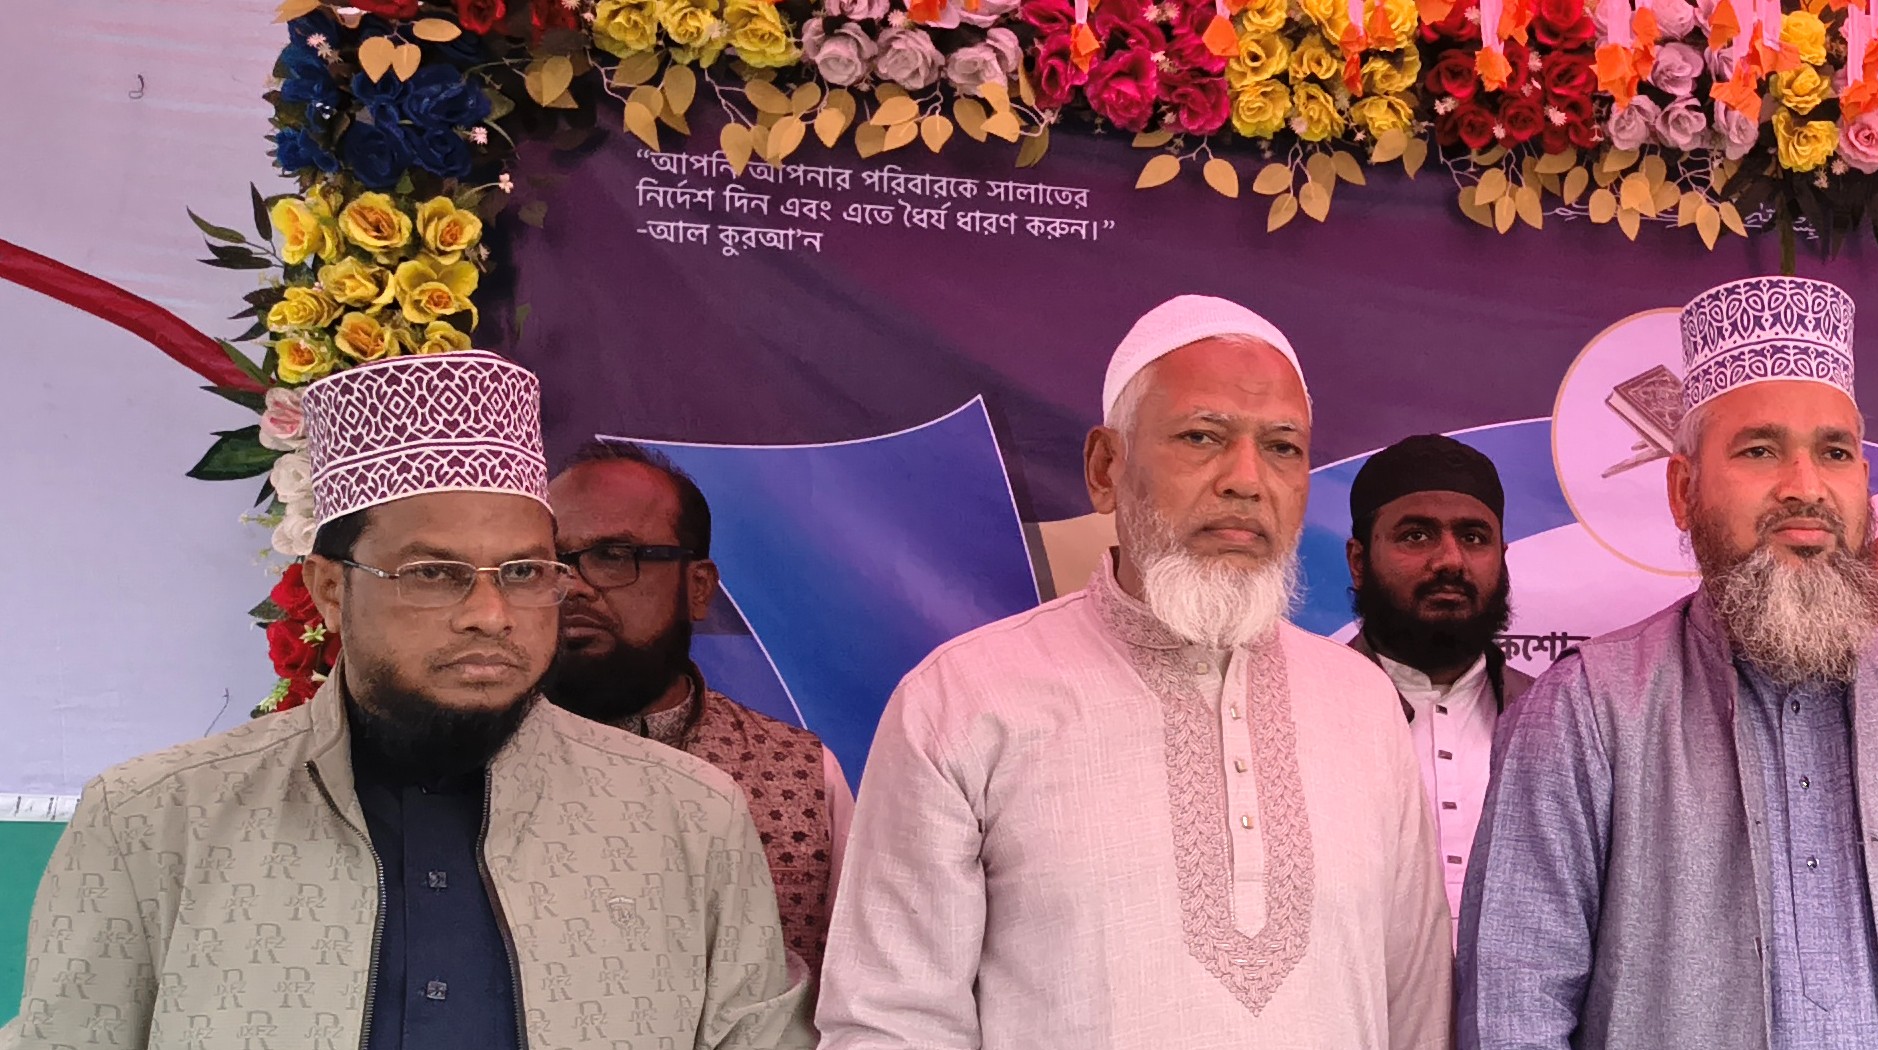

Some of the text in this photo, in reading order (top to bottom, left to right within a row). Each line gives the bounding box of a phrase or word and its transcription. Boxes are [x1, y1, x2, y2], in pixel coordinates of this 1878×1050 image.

[636, 177, 715, 212] নির্দেশ
[723, 183, 771, 215] দিন
[780, 197, 831, 221] এবং
[843, 203, 895, 225] এতে
[898, 199, 951, 230] ধৈর্য
[956, 210, 1018, 236] ধারণ
[862, 164, 979, 199] পরিবারকে
[986, 180, 1090, 210] সালাতের
[636, 220, 711, 246] -আল
